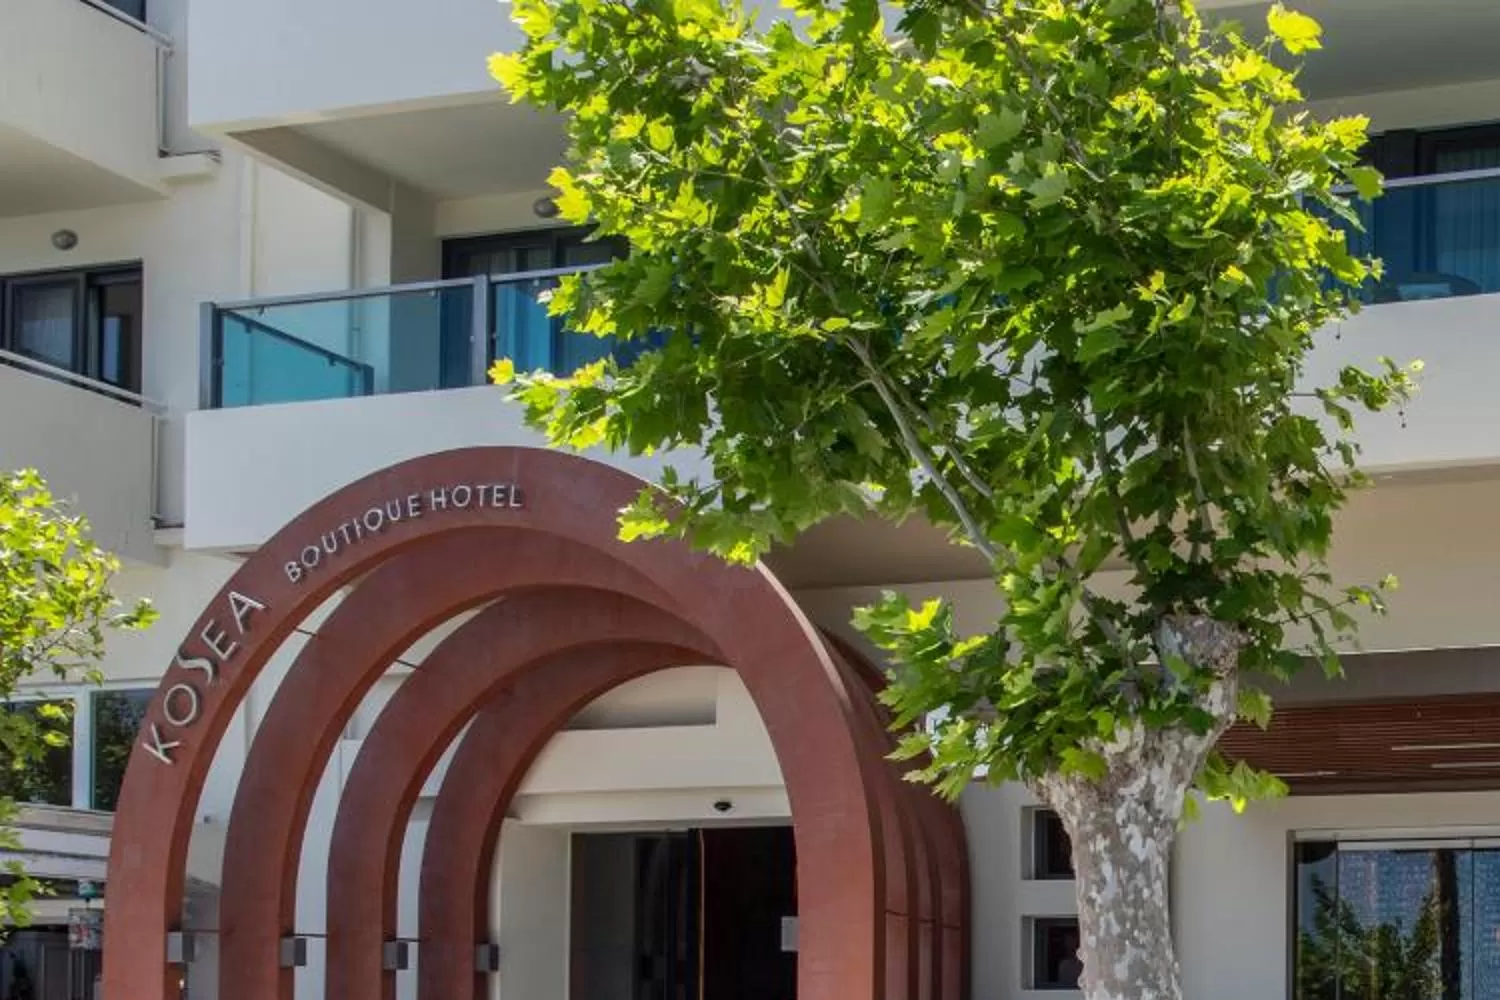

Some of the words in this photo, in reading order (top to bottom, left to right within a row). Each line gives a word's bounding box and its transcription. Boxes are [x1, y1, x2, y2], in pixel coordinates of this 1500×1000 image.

[142, 590, 265, 766] KOSEA
[284, 494, 422, 583] BOUTIQUE
[430, 484, 522, 508] HOTEL
